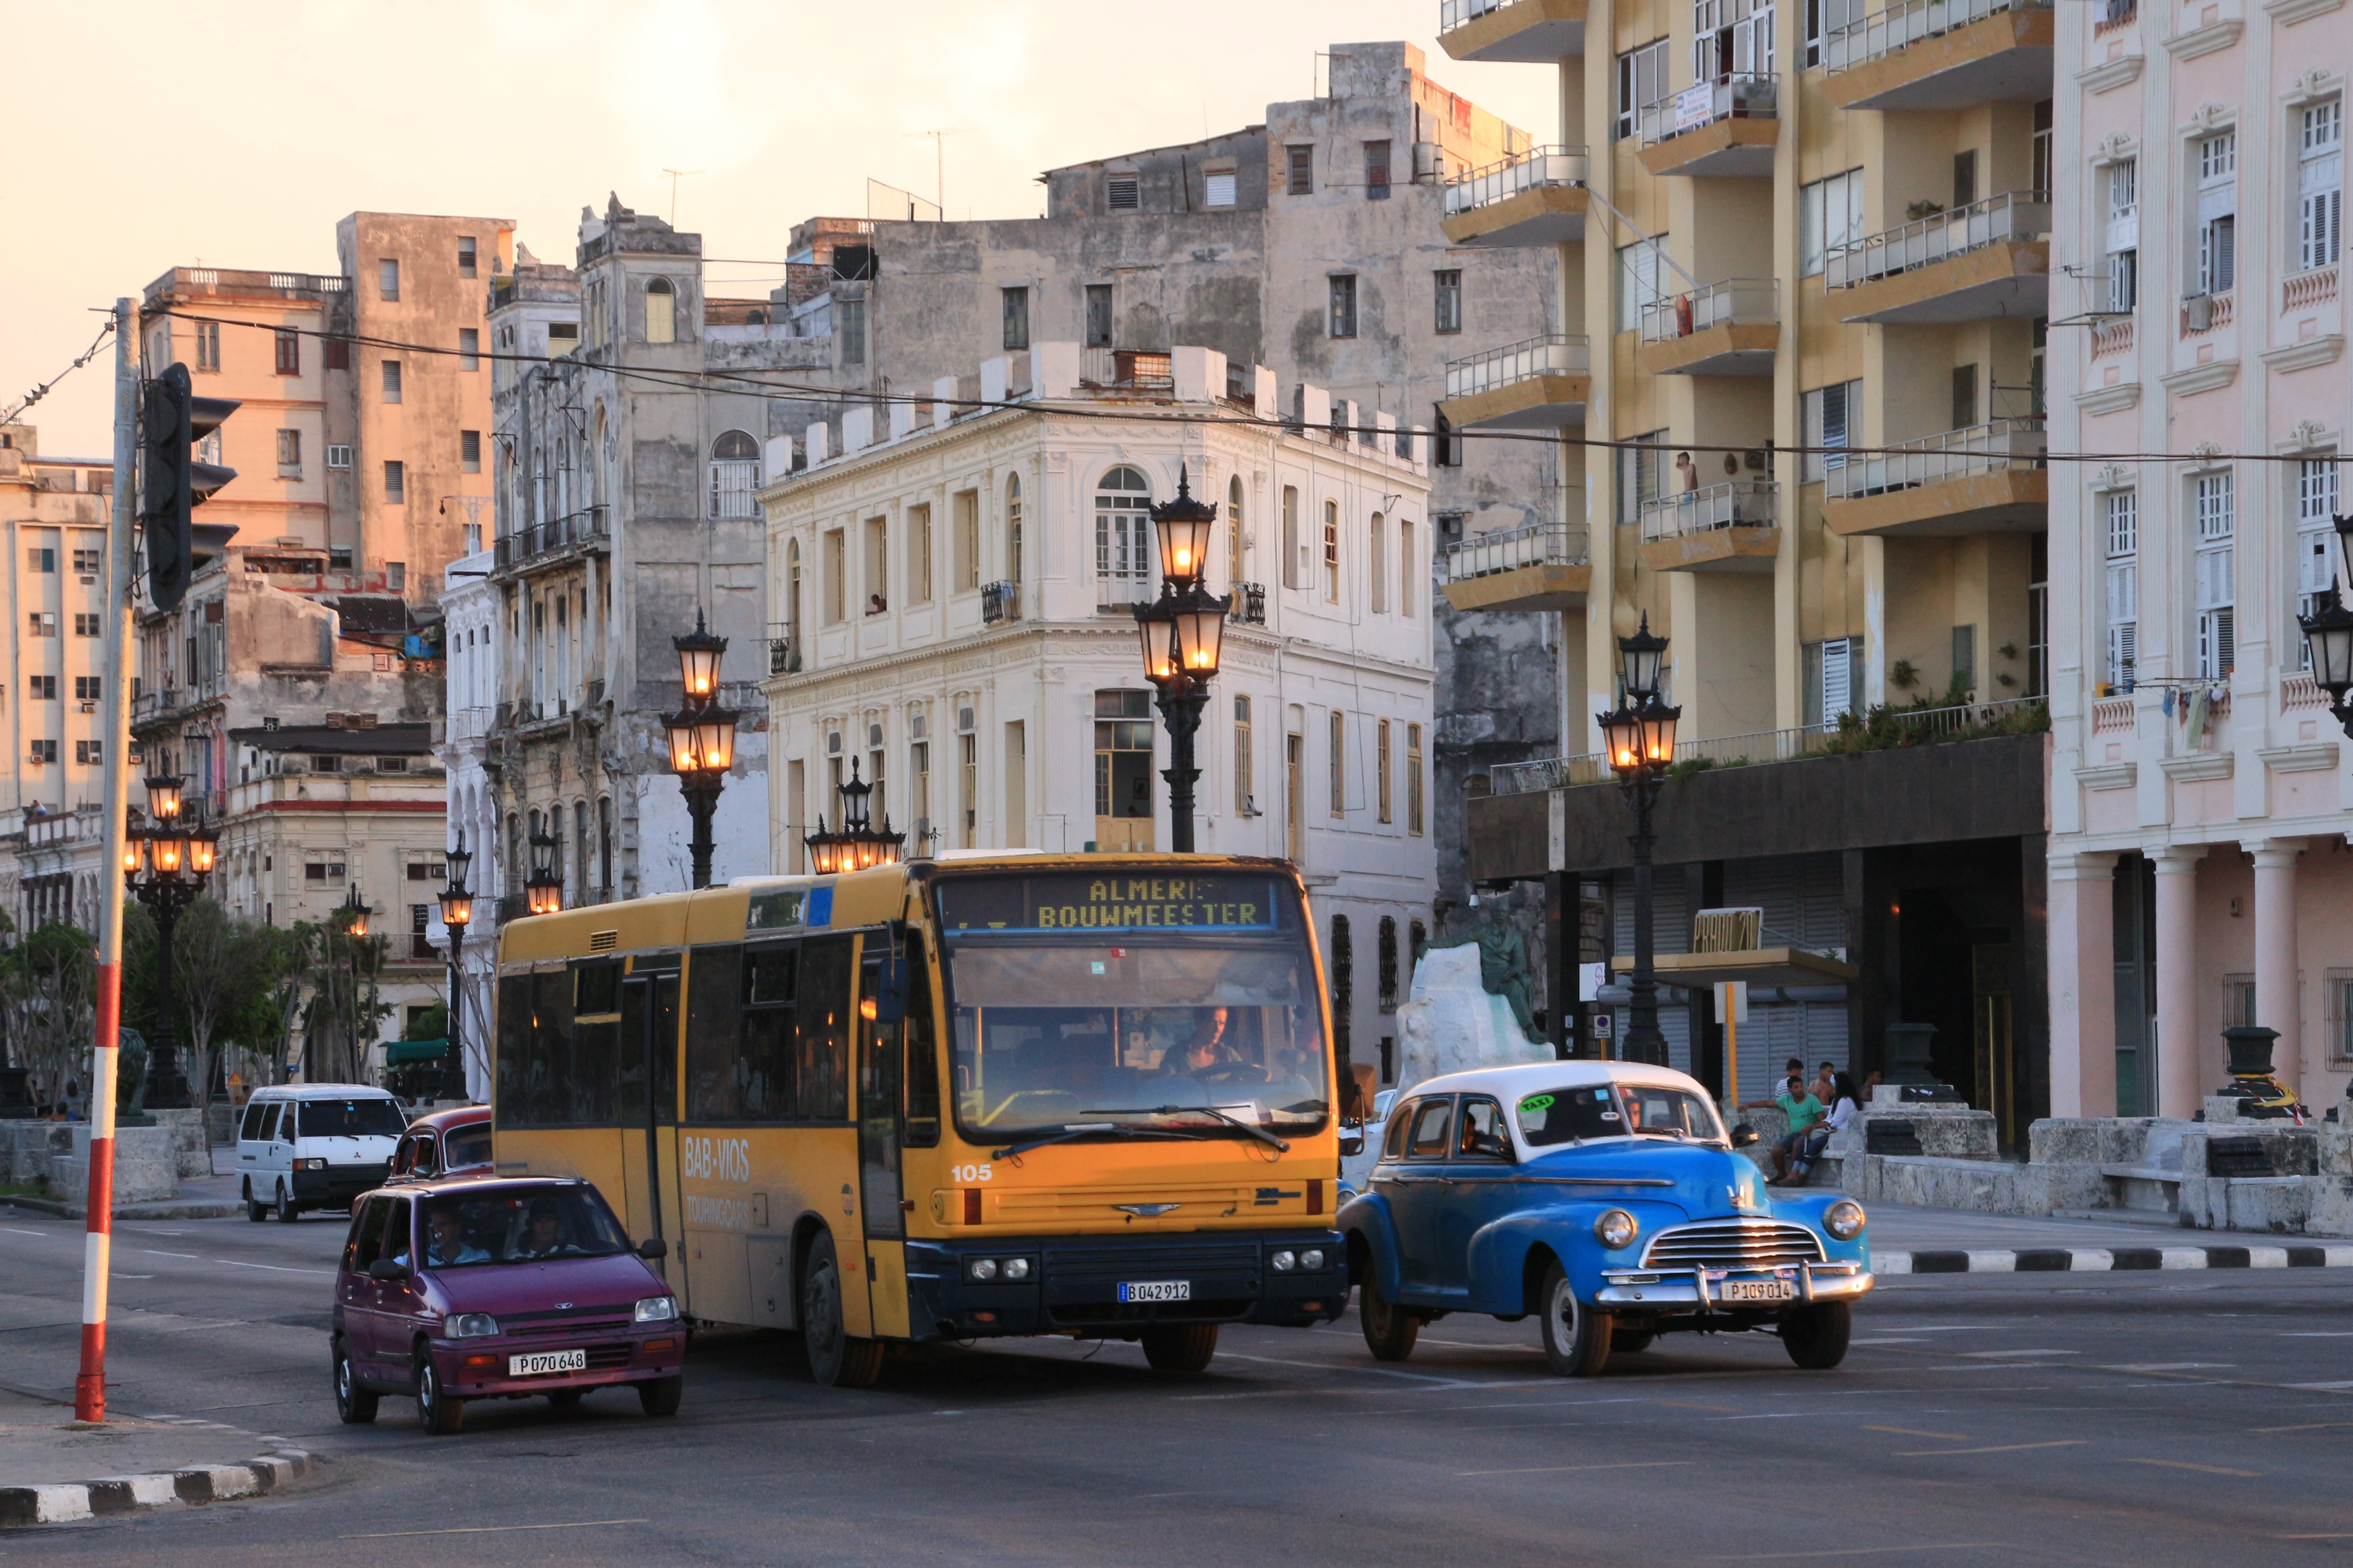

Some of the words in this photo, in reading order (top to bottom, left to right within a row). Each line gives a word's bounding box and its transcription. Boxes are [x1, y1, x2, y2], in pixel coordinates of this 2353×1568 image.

[1522, 1097, 1551, 1111] TAXI
[685, 1136, 750, 1182] BAB-VIOS
[951, 1164, 992, 1182] 105
[1129, 1286, 1136, 1300] B
[1139, 1285, 1162, 1299] 042
[1165, 1284, 1187, 1299] 912
[1732, 1285, 1739, 1299] P
[1742, 1284, 1764, 1299] 109
[1768, 1284, 1790, 1298] 014
[520, 1359, 528, 1373] P
[531, 1356, 556, 1372] 070
[559, 1353, 583, 1369] 648
